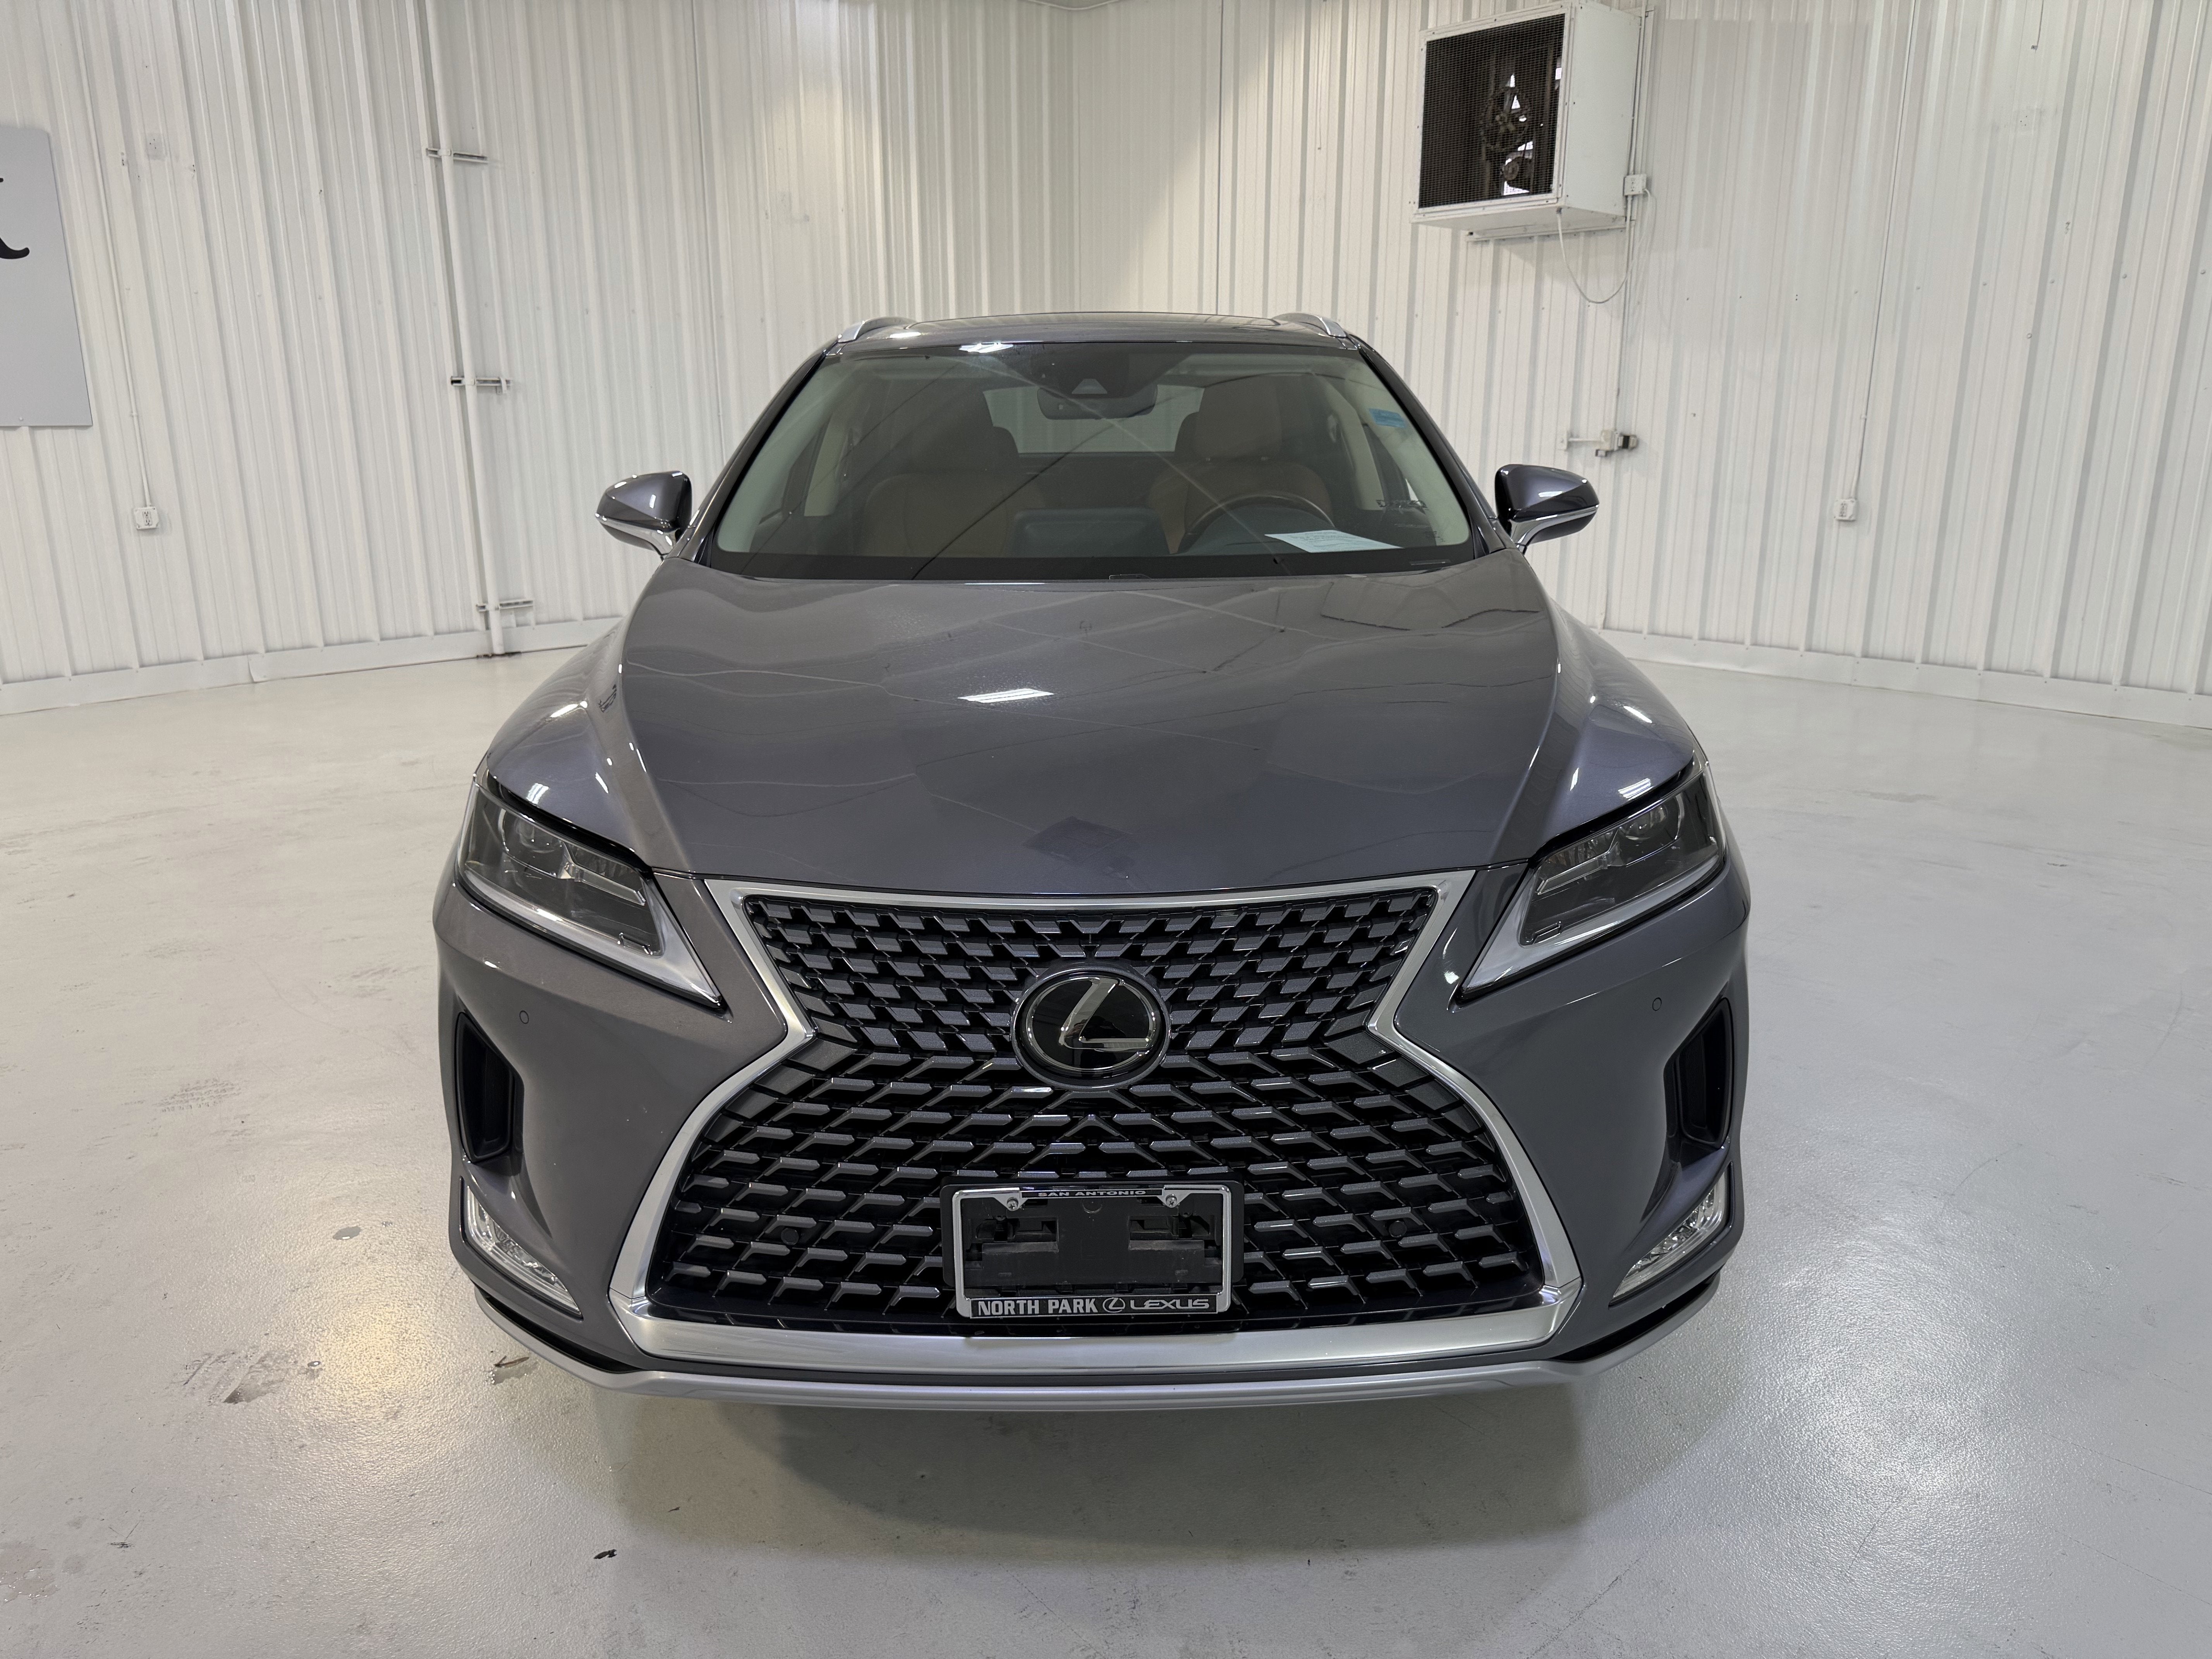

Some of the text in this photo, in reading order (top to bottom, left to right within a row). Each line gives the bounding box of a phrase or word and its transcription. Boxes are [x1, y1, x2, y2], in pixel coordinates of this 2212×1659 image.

[978, 1299, 1039, 1316] NORTH
[1048, 1298, 1098, 1314] PARK
[1130, 1299, 1209, 1310] LEXUS
